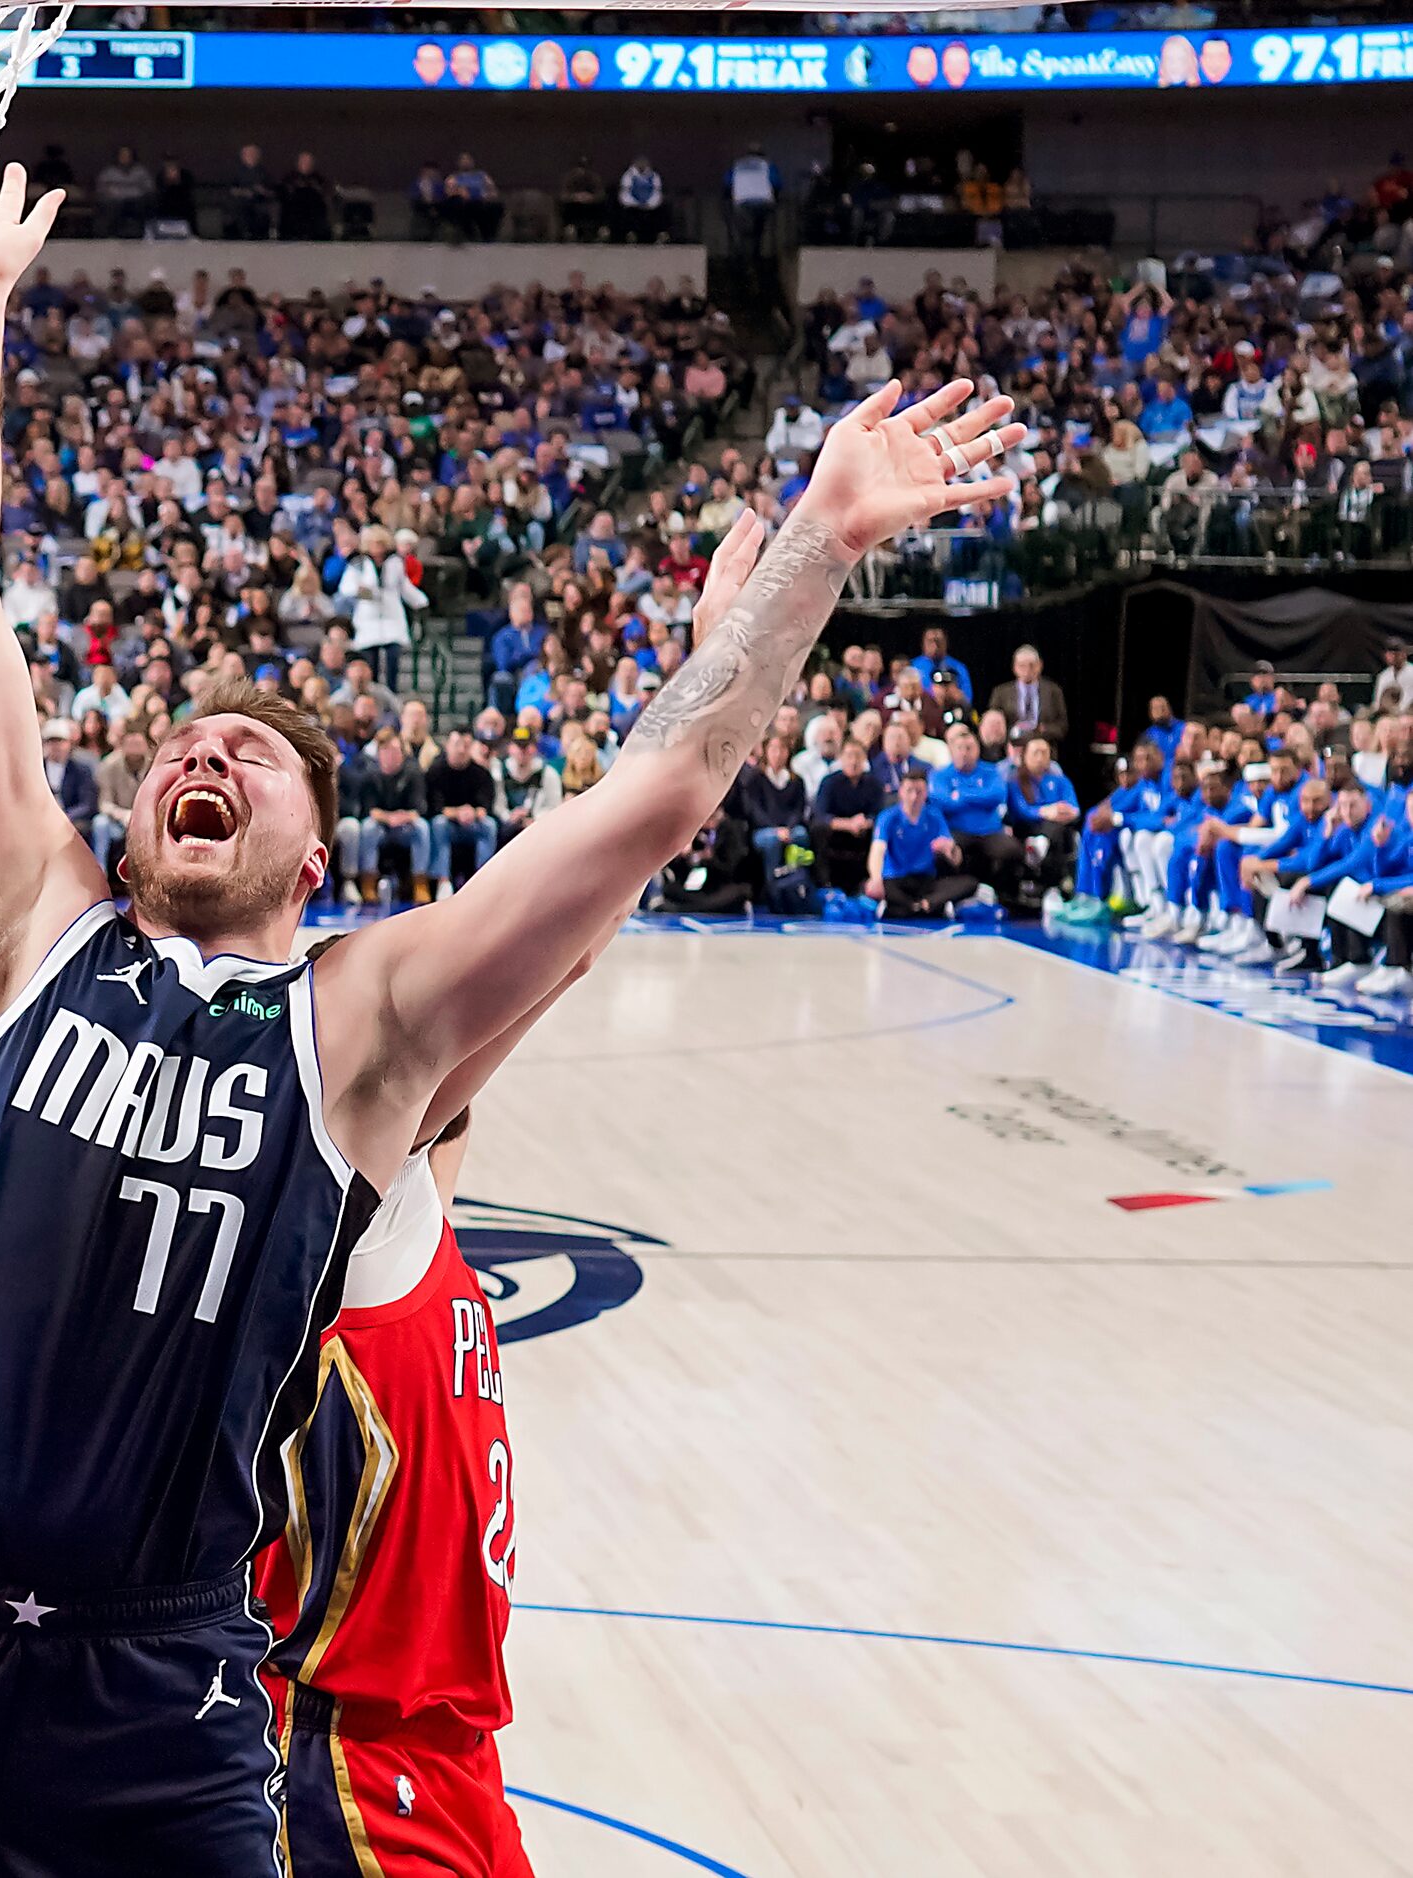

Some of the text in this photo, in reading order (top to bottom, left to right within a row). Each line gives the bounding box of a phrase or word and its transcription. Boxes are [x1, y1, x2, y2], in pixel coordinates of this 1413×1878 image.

[60, 55, 82, 79] 3
[133, 56, 155, 79] 6
[615, 40, 716, 88] 97.1
[717, 59, 828, 88] FREAK
[1252, 33, 1359, 82] 97.1
[11, 1007, 268, 1171] MAVS
[119, 1177, 246, 1324] 77
